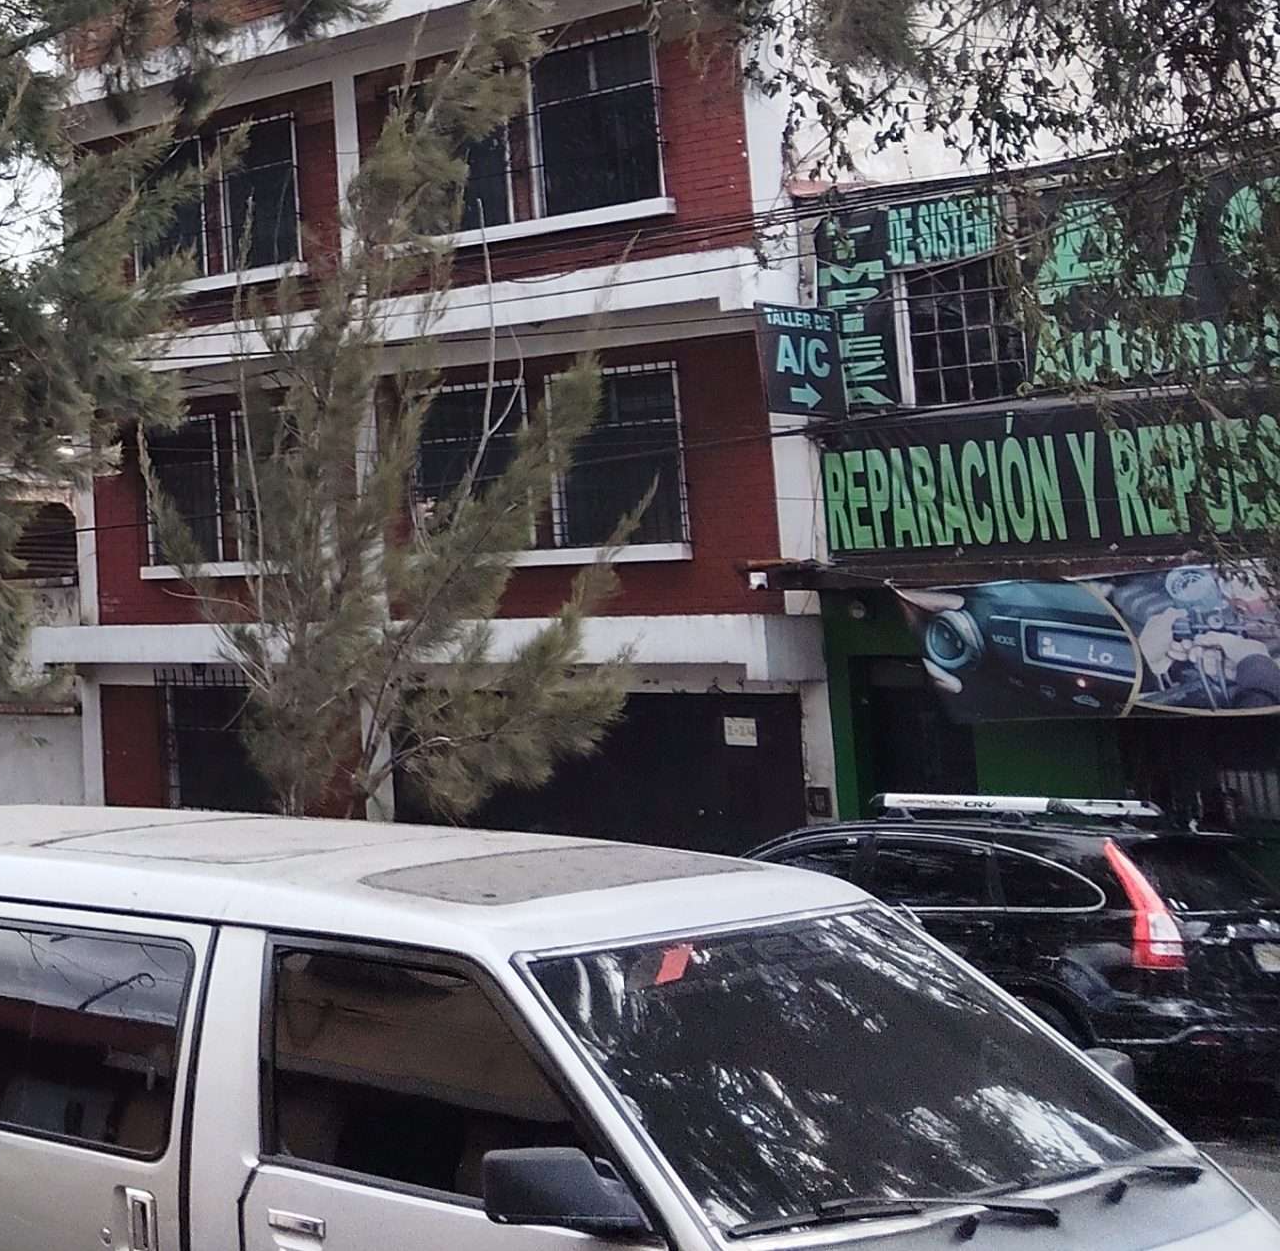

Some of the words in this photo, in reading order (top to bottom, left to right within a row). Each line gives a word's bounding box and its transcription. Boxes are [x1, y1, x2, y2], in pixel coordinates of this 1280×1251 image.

[887, 207, 917, 266] DE
[763, 307, 813, 329] TALLER
[814, 314, 832, 332] DE
[776, 334, 831, 378] A/C
[825, 411, 1068, 550] REPARACIÓN
[1065, 431, 1100, 539] Y
